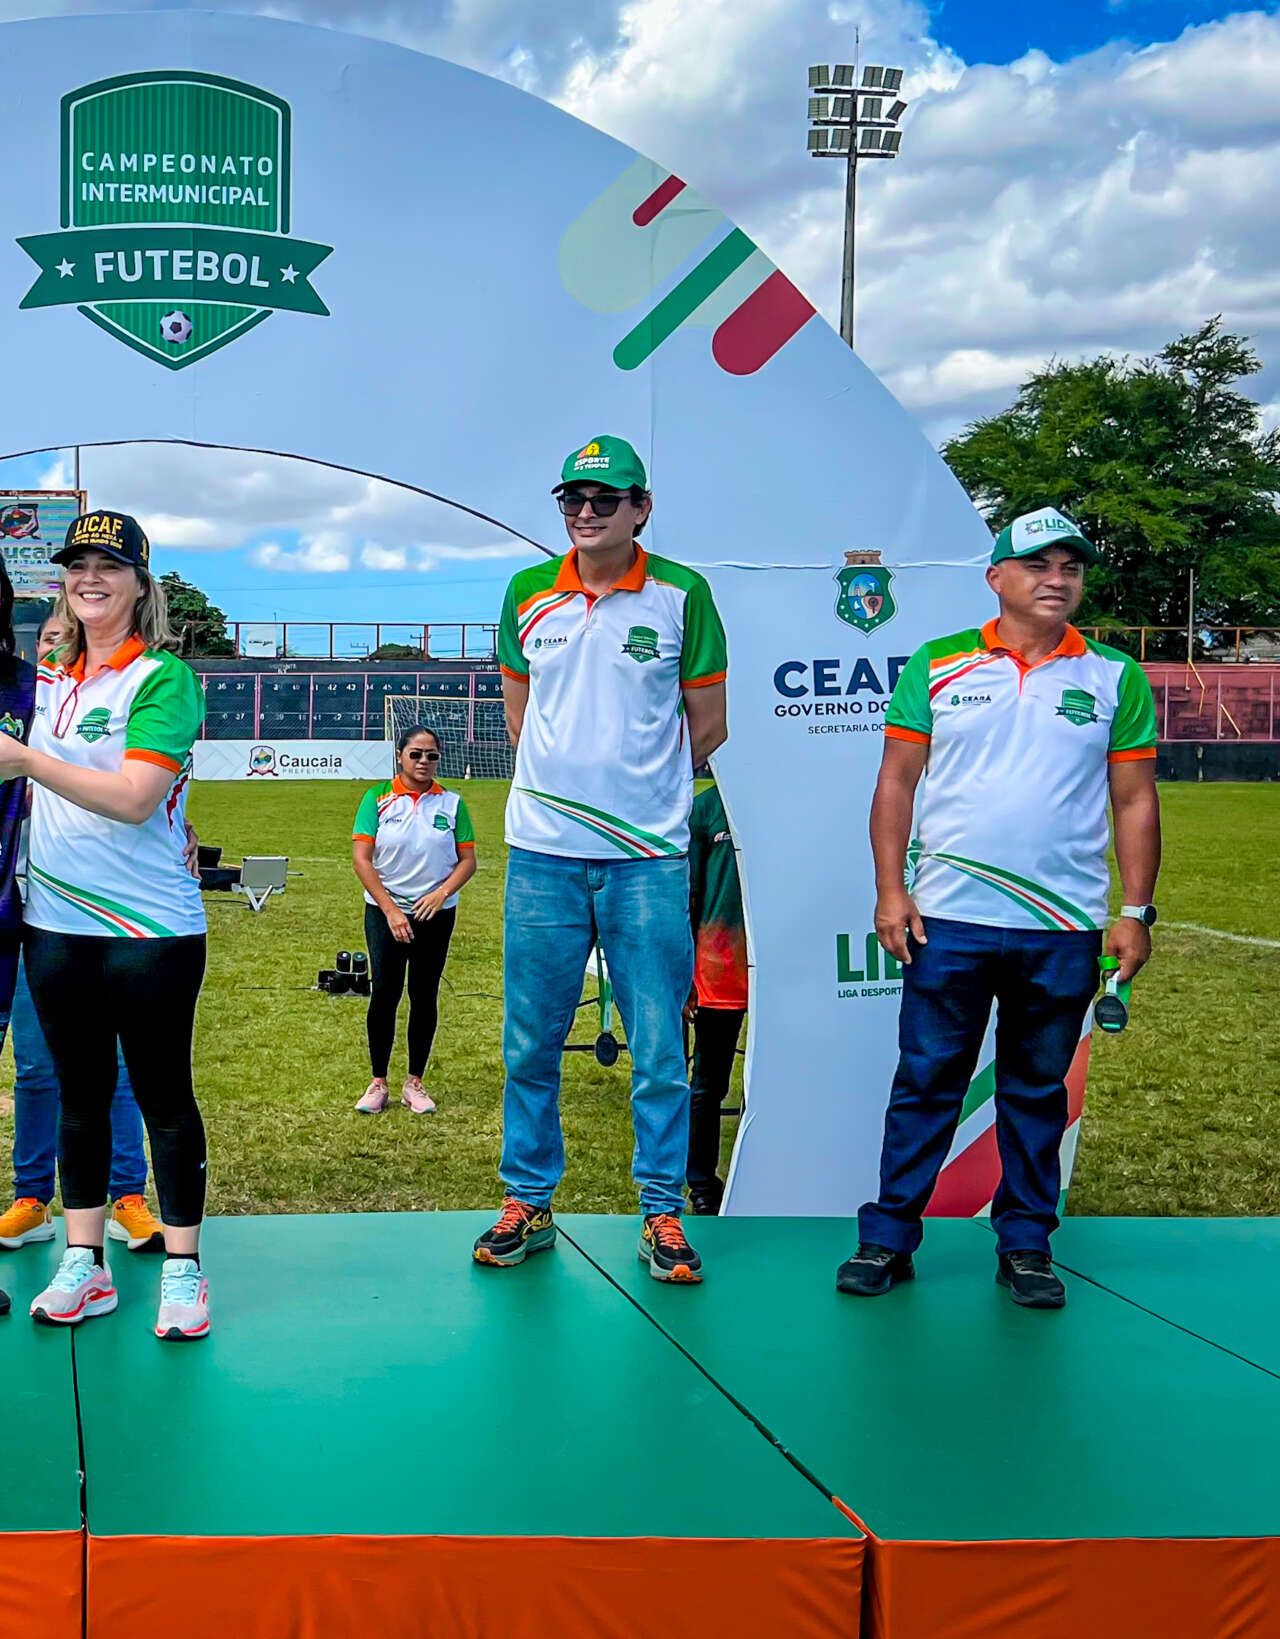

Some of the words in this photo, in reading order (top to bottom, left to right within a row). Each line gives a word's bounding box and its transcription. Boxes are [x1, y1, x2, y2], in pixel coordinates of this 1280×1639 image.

[81, 152, 274, 176] CAMPEONATO
[81, 182, 270, 206] INTERMUNICIPAL
[94, 249, 270, 288] FUTEBOL
[75, 515, 123, 536] LICAF
[544, 635, 567, 645] CEARÁ
[773, 656, 911, 698] CEA
[962, 694, 991, 702] CEARÁ
[774, 702, 863, 717] GOVERNO
[808, 724, 869, 735] SECRETARIA
[279, 754, 342, 767] Caucaia
[838, 989, 858, 998] LIGA
[861, 987, 903, 997] DESPORT
